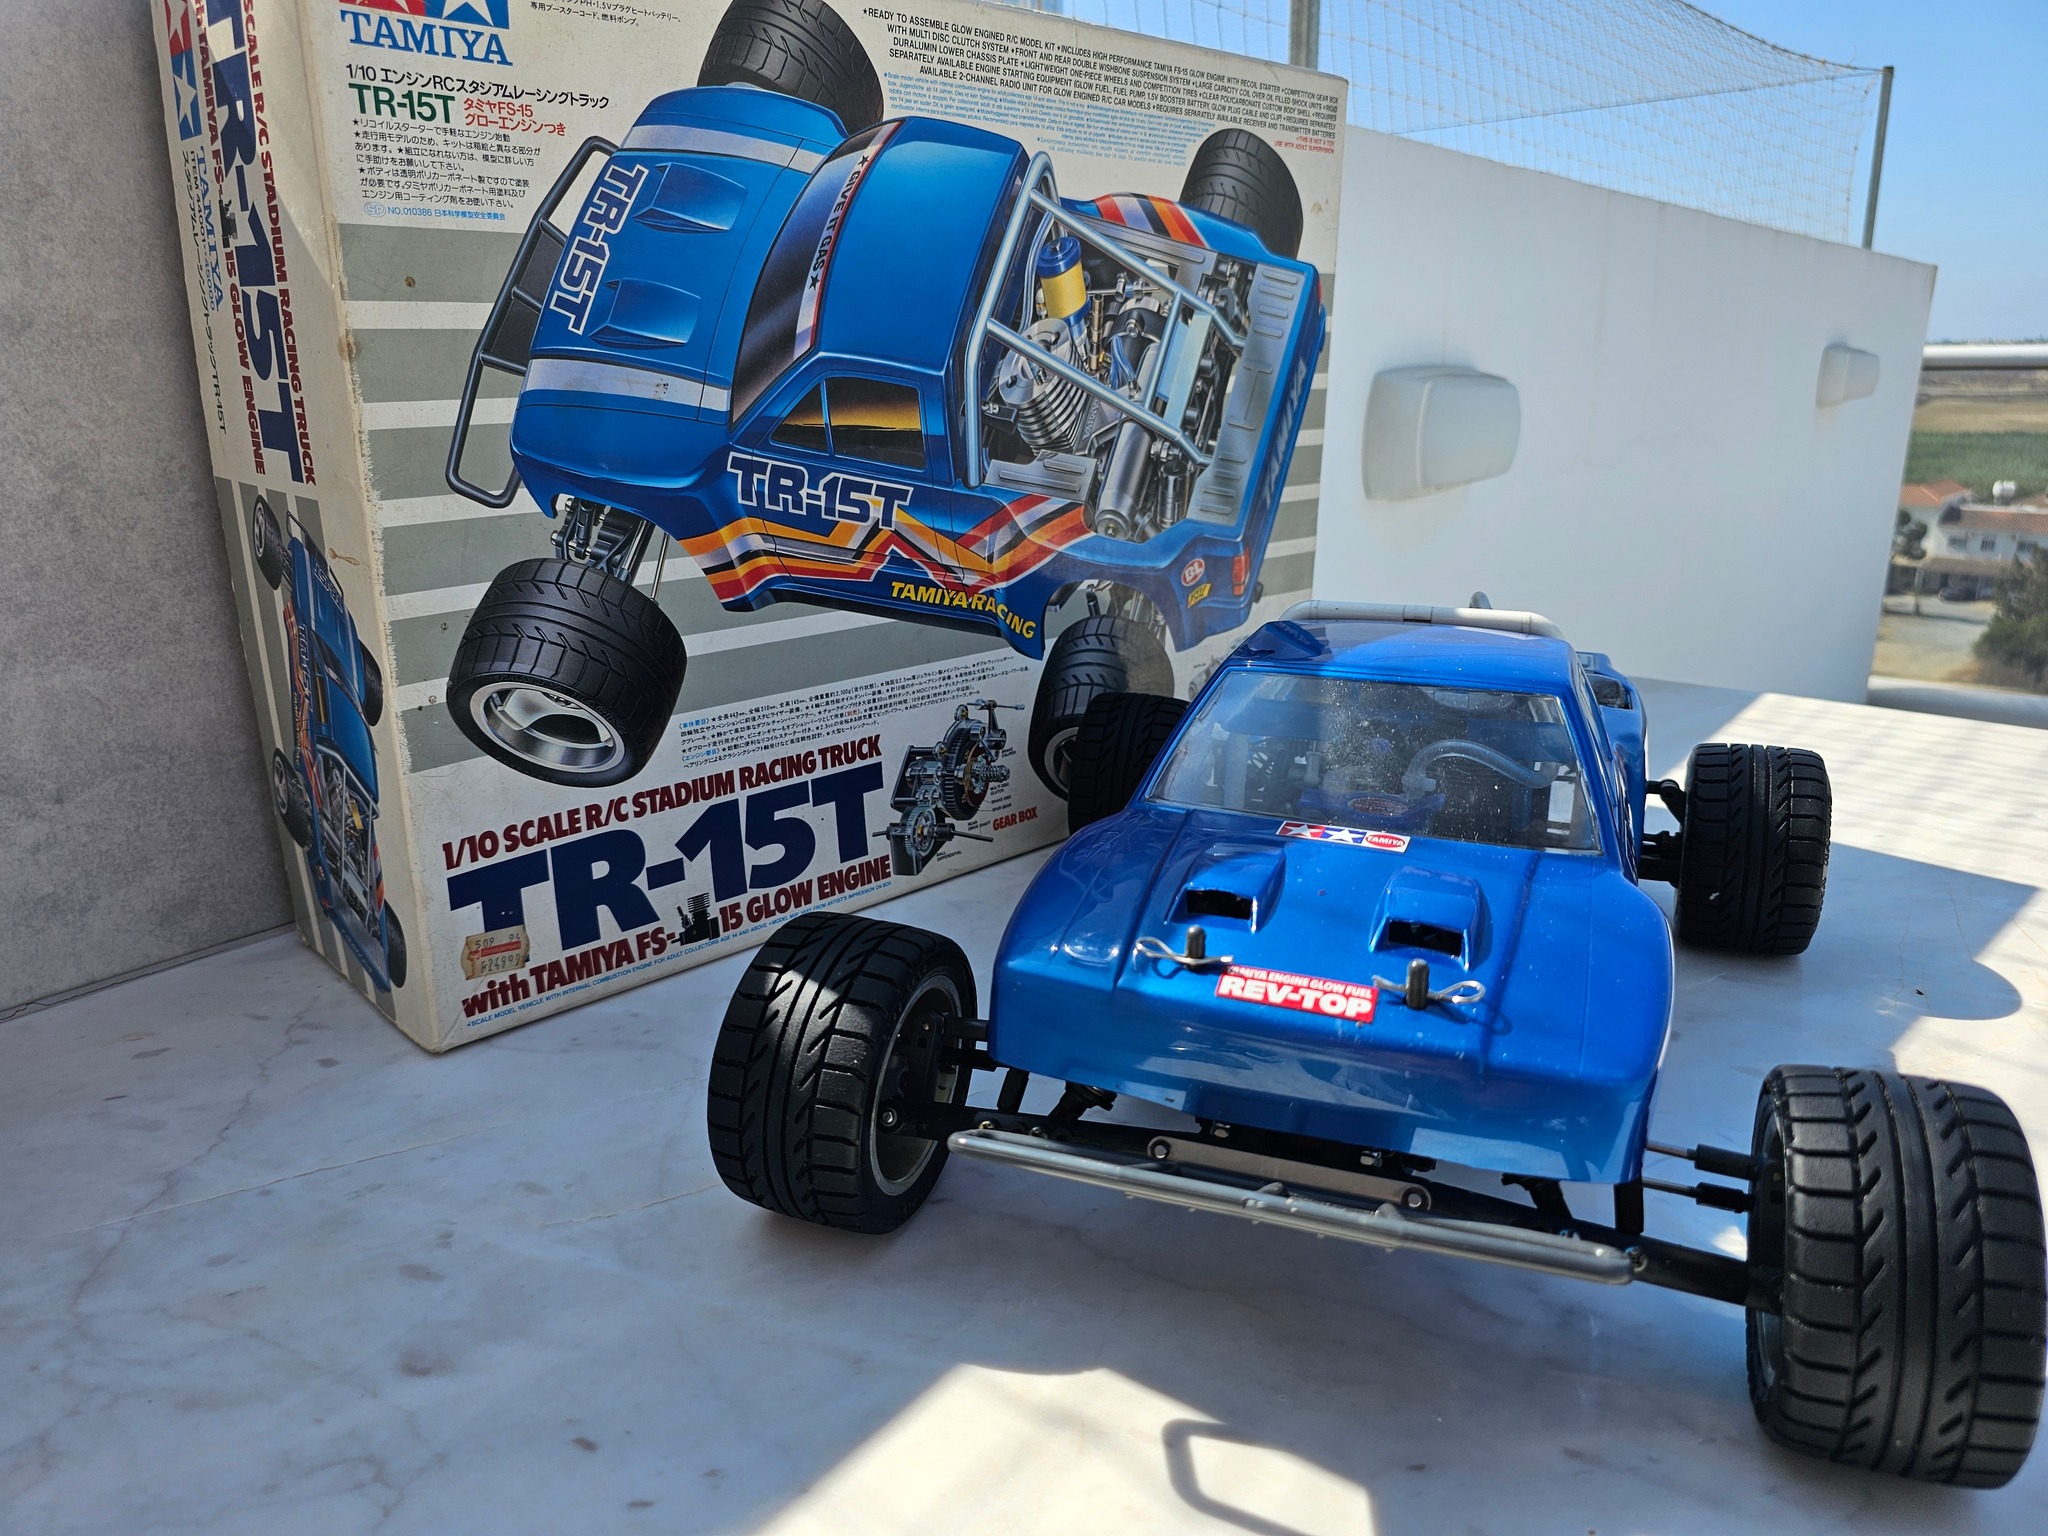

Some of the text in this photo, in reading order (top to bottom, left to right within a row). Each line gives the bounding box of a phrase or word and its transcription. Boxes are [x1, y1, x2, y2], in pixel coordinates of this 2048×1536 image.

[340, 10, 512, 66] TAMIYA
[868, 8, 1280, 93] READY TO ASSEMBLE GLOW ENGINED R/C MODEL KIT INCLUDES HIGH PERFORMANCE TAMIYA FS-15 GLOW ENGINE WITH STARTER
[887, 24, 1238, 95] WITH MULTI DISC CLUTCH SYSTEM FRONT AND REAR DOUBLE WISHBONE SUSPENSION SYSTEM LARGE CAPACITY
[346, 64, 610, 109] 1/10 エンジンRCスタジアムレーシングトラック
[348, 83, 456, 123] TR-15T
[888, 49, 1240, 115] SEPARATELY AVAILABLE ENGINE STARTING EQUIPMENT FUEL, FUEL PUMP, 1.5V BOOSTER BATTERY, GLOW PLUG
[893, 37, 1261, 108] DURALUMIN LOWER CHASSIS PLATE LIGHTWEIGHT ONE-PIECE WHEELS AND COMPETITION TIRES CLEAR POLYCARBONATE
[919, 66, 1242, 124] AVAILABLE 2-CHANNEL RADIO UNIT FOR GLOW ENGINED R/C CAR MODELS REQUIRES SEPARATELY AVAILABLE
[464, 98, 534, 118] タミヤFS-15
[465, 114, 566, 136] グローエンジンつき
[190, 150, 199, 190] ITEM
[196, 146, 224, 312] TAMIYA
[205, 0, 304, 483] TR-15T
[244, 0, 316, 486] SCALE R/C STADIUM RACING TRUCK
[388, 206, 432, 217] NO.010386
[812, 170, 861, 272] GIVE IT GAS
[198, 27, 218, 146] TAMIYA
[224, 250, 236, 278] 15
[230, 282, 250, 370] GLOW
[242, 376, 266, 476] ENGINE
[550, 164, 648, 335] TR-15T
[726, 452, 914, 530] TR-15T
[891, 581, 1036, 638] TAMIYA RACING
[442, 734, 882, 870] 1/10 SCALE R/C STADIUM RACING TRUCK
[992, 806, 1038, 831] GEAR BOX
[446, 762, 884, 962] TR-15T
[1366, 834, 1405, 846] TAMIYA
[462, 855, 891, 1018] with TAMIYA FS- 15 GLOW ENGINE
[471, 917, 788, 1027] SCALE MODEL VEHICLE WITH INTERNAL COMBUSTION ENGINE FOR ADULT COLLECTORS AGE AND MODEL
[1218, 974, 1372, 1018] REV-TOP
[1228, 966, 1372, 998] TAMIYA ENGINE GLOW FUEL
